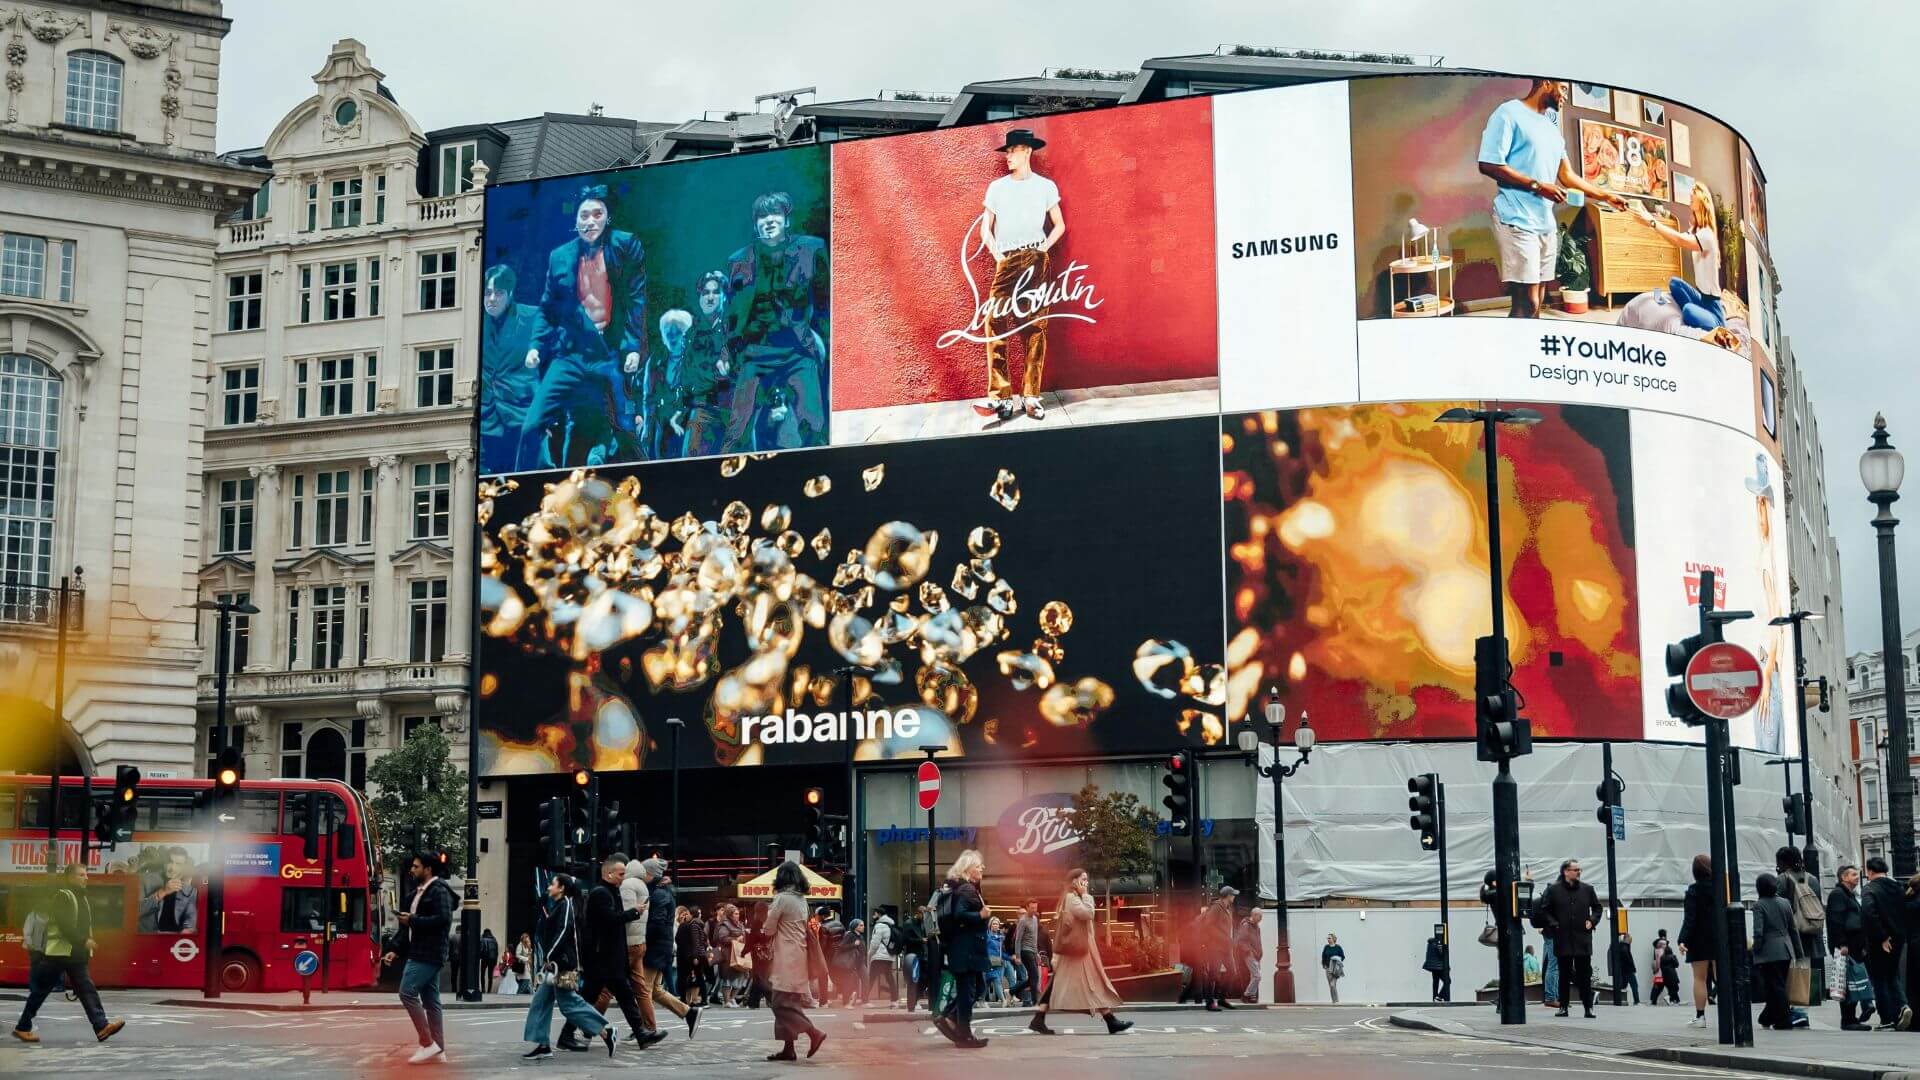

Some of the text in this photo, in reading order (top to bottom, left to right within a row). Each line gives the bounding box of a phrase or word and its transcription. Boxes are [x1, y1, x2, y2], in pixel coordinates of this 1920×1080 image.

[1615, 133, 1643, 167] 18
[1231, 232, 1339, 260] SAMSUNG
[936, 213, 1104, 349] Louboutin
[1540, 334, 1667, 367] #YouMake
[1529, 363, 1677, 392] Design your space
[741, 708, 921, 745] rabanne
[11, 842, 101, 866] TULS KIG
[281, 863, 303, 879] Go
[742, 886, 770, 896] HOT
[809, 886, 837, 897] POT
